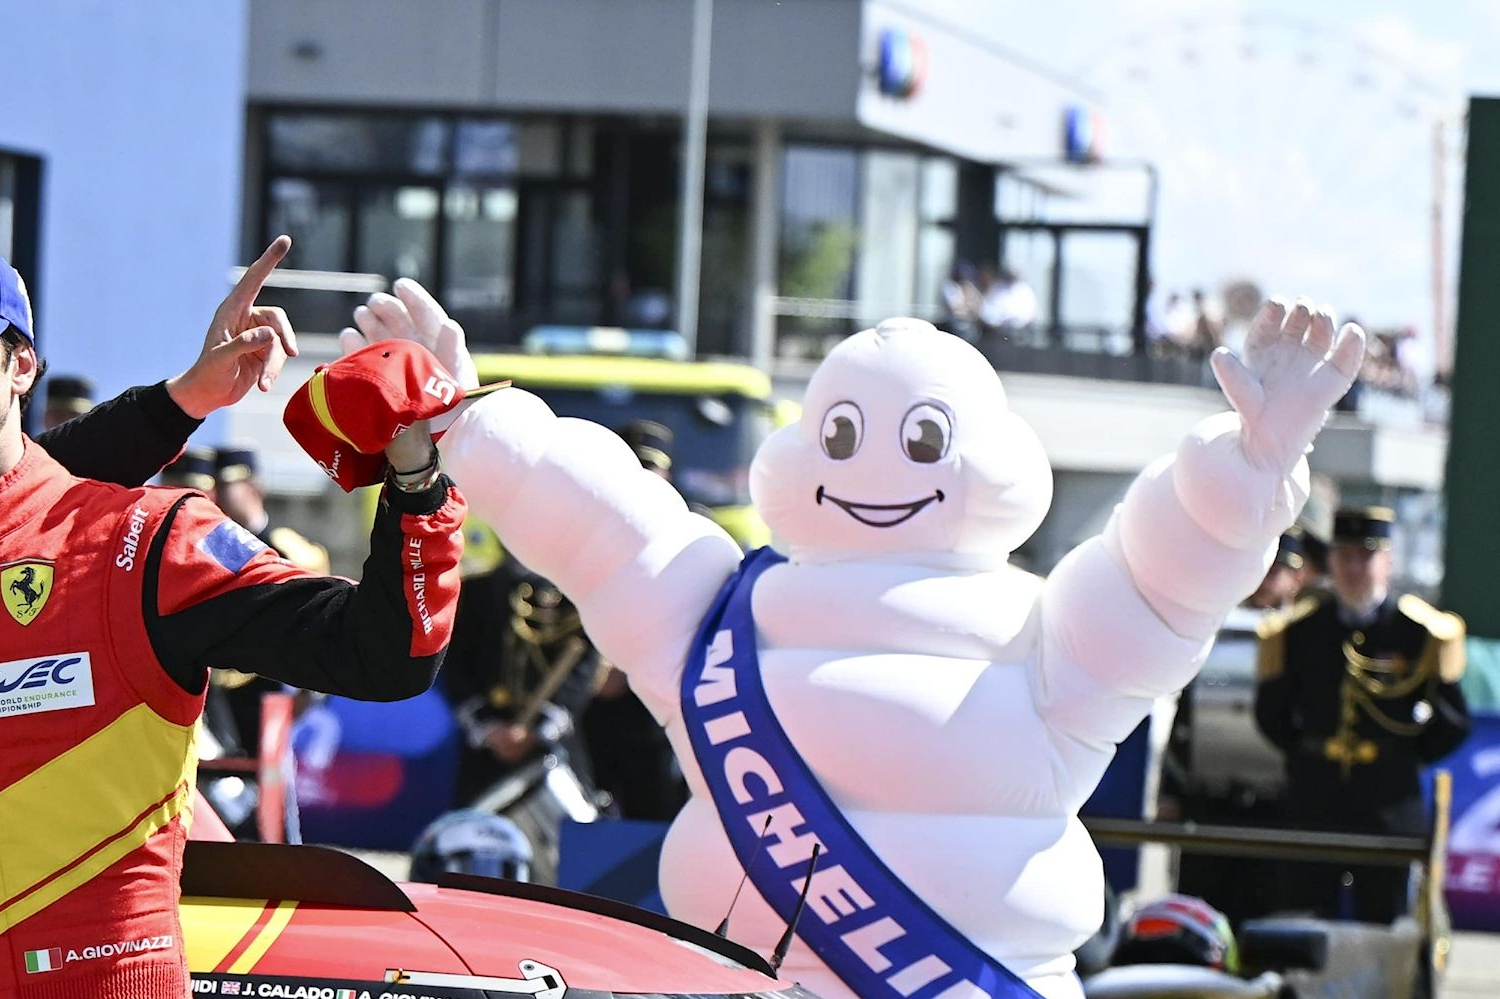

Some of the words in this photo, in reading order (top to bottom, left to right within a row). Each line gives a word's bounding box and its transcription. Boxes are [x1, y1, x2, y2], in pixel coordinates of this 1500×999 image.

[116, 506, 147, 572] Sabelt
[24, 689, 78, 703] ENDURANCE
[65, 934, 174, 963] A.GIOVINAZZI
[242, 982, 255, 997] J.
